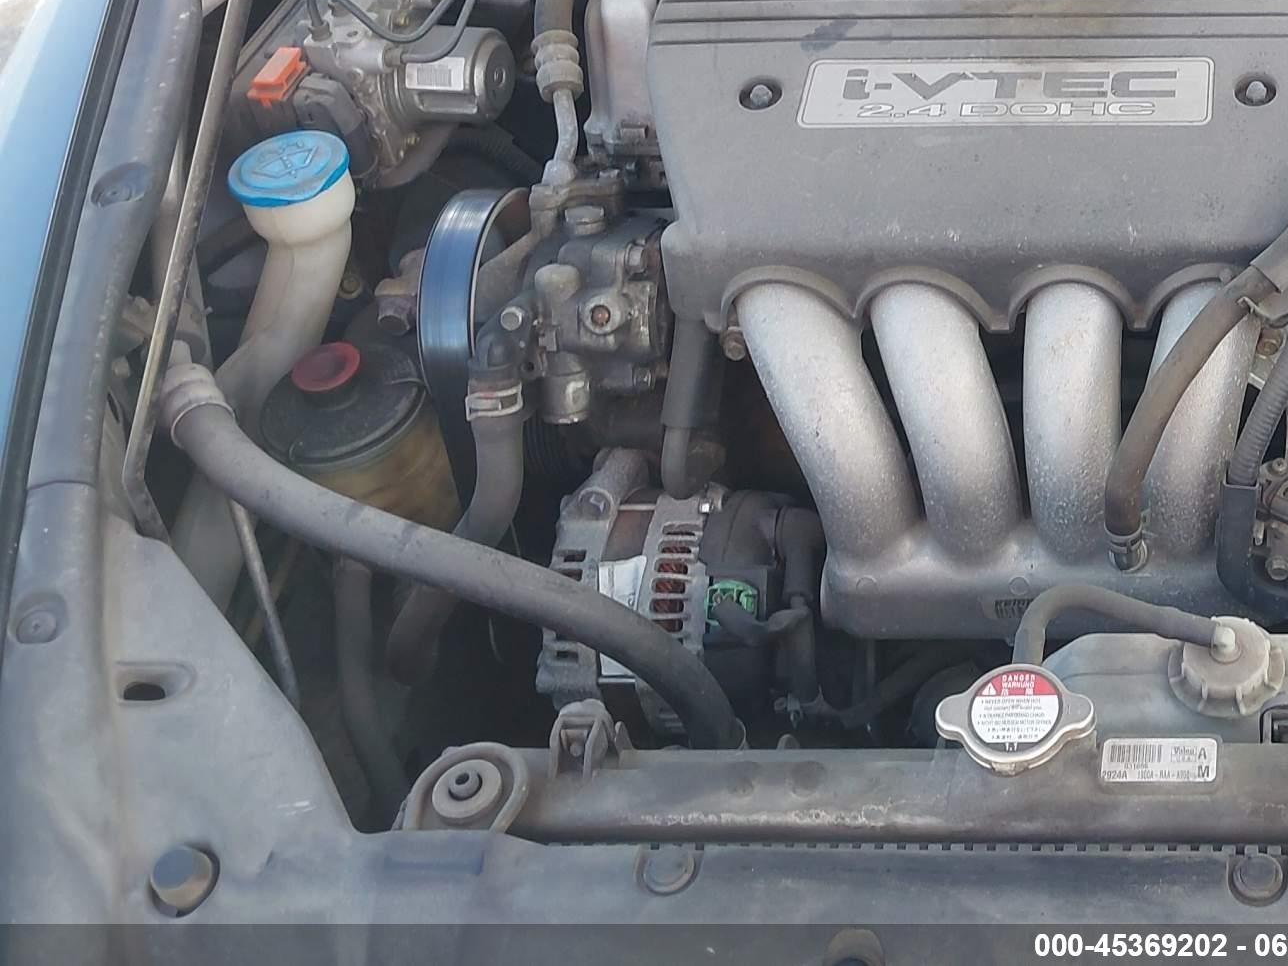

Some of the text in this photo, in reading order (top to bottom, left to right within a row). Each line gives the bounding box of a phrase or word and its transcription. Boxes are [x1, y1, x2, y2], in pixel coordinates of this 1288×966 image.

[842, 68, 1178, 101] i-VTEC
[857, 101, 1156, 118] 2.4 DOHC
[1001, 674, 1036, 682] DANGER
[1005, 742, 1018, 752] 1.1
[1198, 747, 1207, 760] A
[1198, 765, 1209, 778] M
